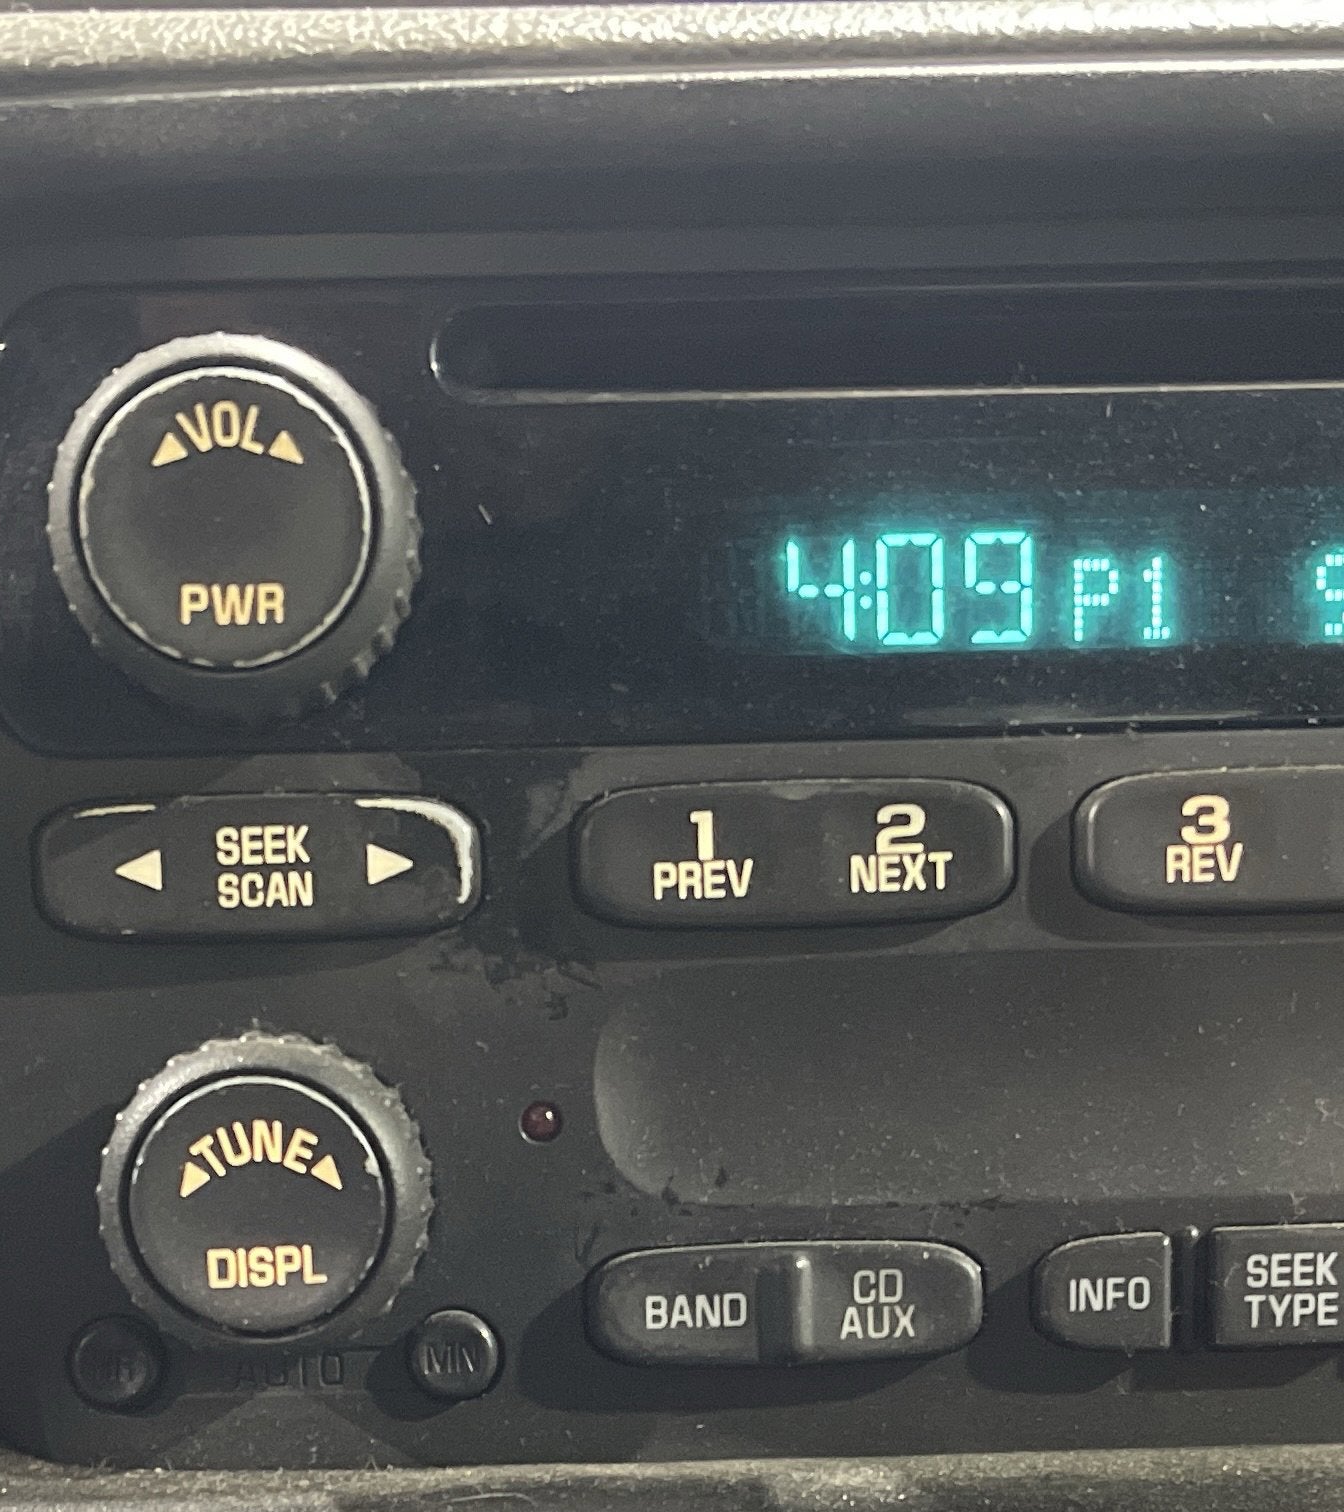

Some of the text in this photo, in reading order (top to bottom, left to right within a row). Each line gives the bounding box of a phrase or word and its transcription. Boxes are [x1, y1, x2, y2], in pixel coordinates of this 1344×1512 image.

[176, 401, 264, 453] VOL
[179, 583, 286, 626] PWR
[785, 531, 1171, 646] 4:09 P1
[689, 809, 715, 861] 1
[875, 803, 926, 856] 2
[1180, 794, 1231, 845] 3
[216, 825, 311, 865] SEEK
[1166, 842, 1244, 883] REV
[218, 871, 314, 908] SCAN
[653, 858, 754, 900] PREV
[850, 851, 953, 893] NEXT
[189, 1119, 319, 1177] TUNE
[206, 1244, 328, 1289] DISPL
[853, 1269, 904, 1304] CD
[1246, 1252, 1339, 1288] SEEK
[645, 1293, 747, 1330] BAND
[1069, 1277, 1151, 1312] INFO
[1244, 1292, 1339, 1328] TYPE
[840, 1305, 916, 1340] AUX
